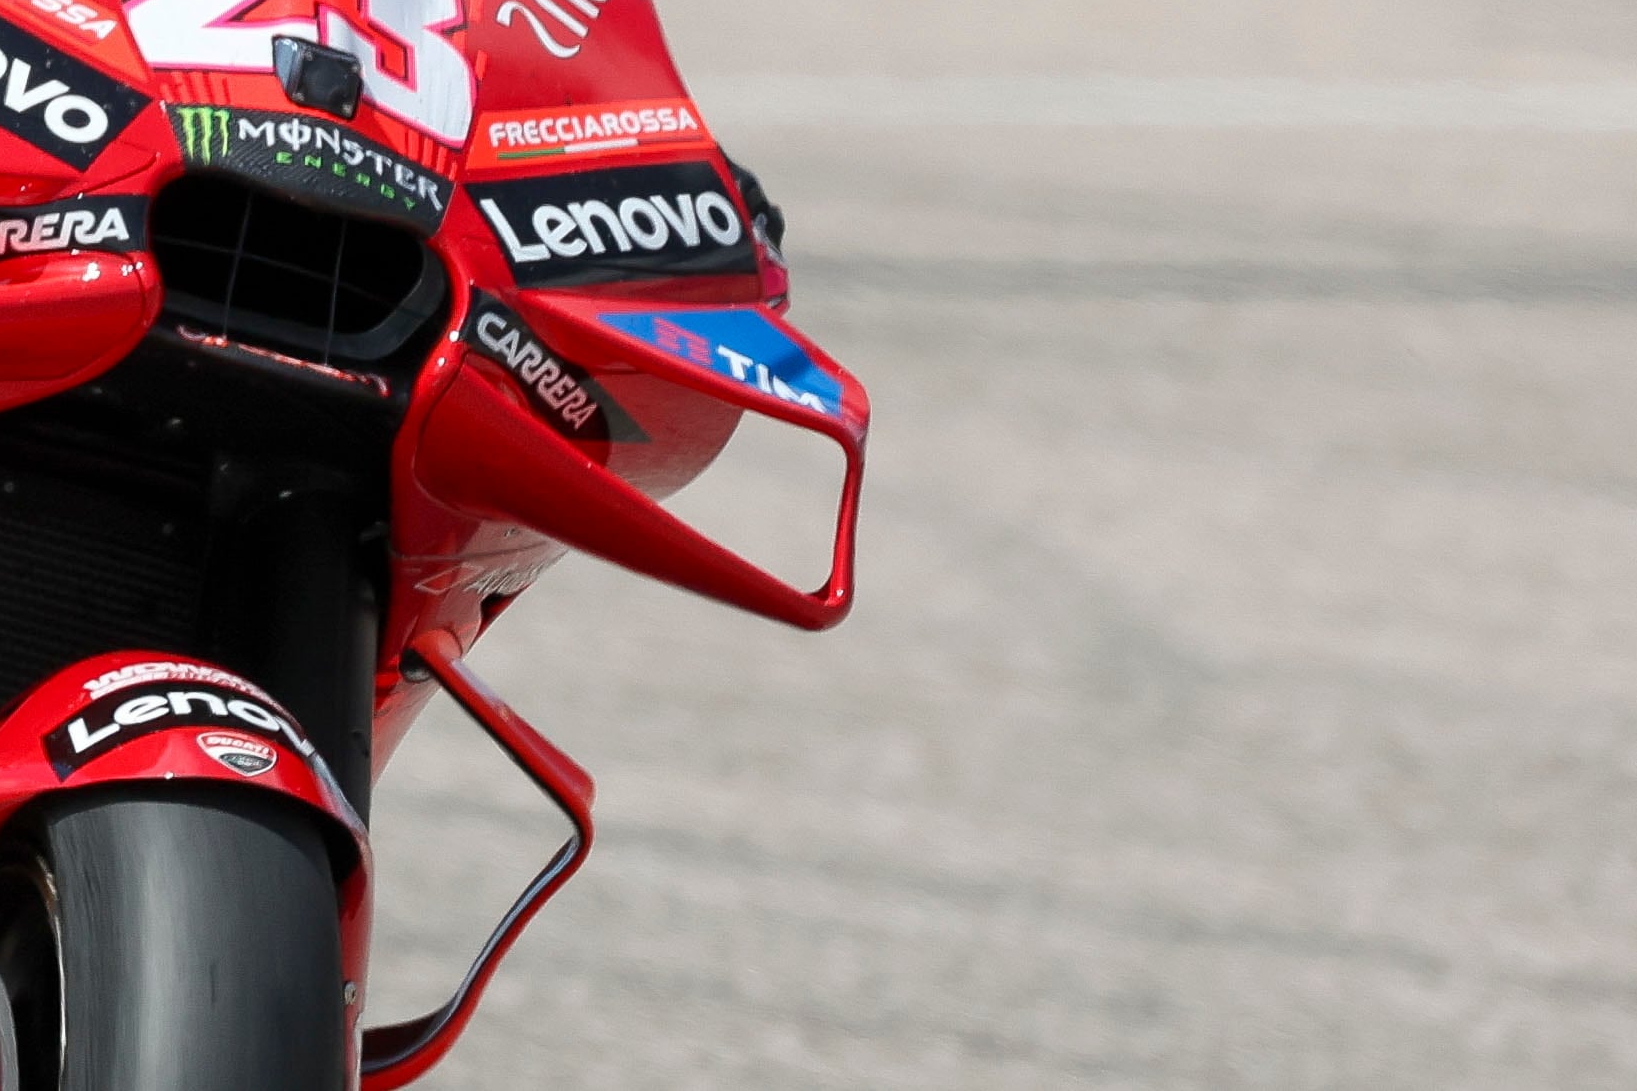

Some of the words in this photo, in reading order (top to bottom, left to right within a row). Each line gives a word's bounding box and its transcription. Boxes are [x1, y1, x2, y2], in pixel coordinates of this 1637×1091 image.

[237, 117, 443, 212] MONSTER
[490, 107, 699, 149] FRECCIAROSSA
[480, 189, 742, 264] Lenovo
[476, 311, 598, 432] CARRERA
[206, 735, 270, 756] DUCATI
